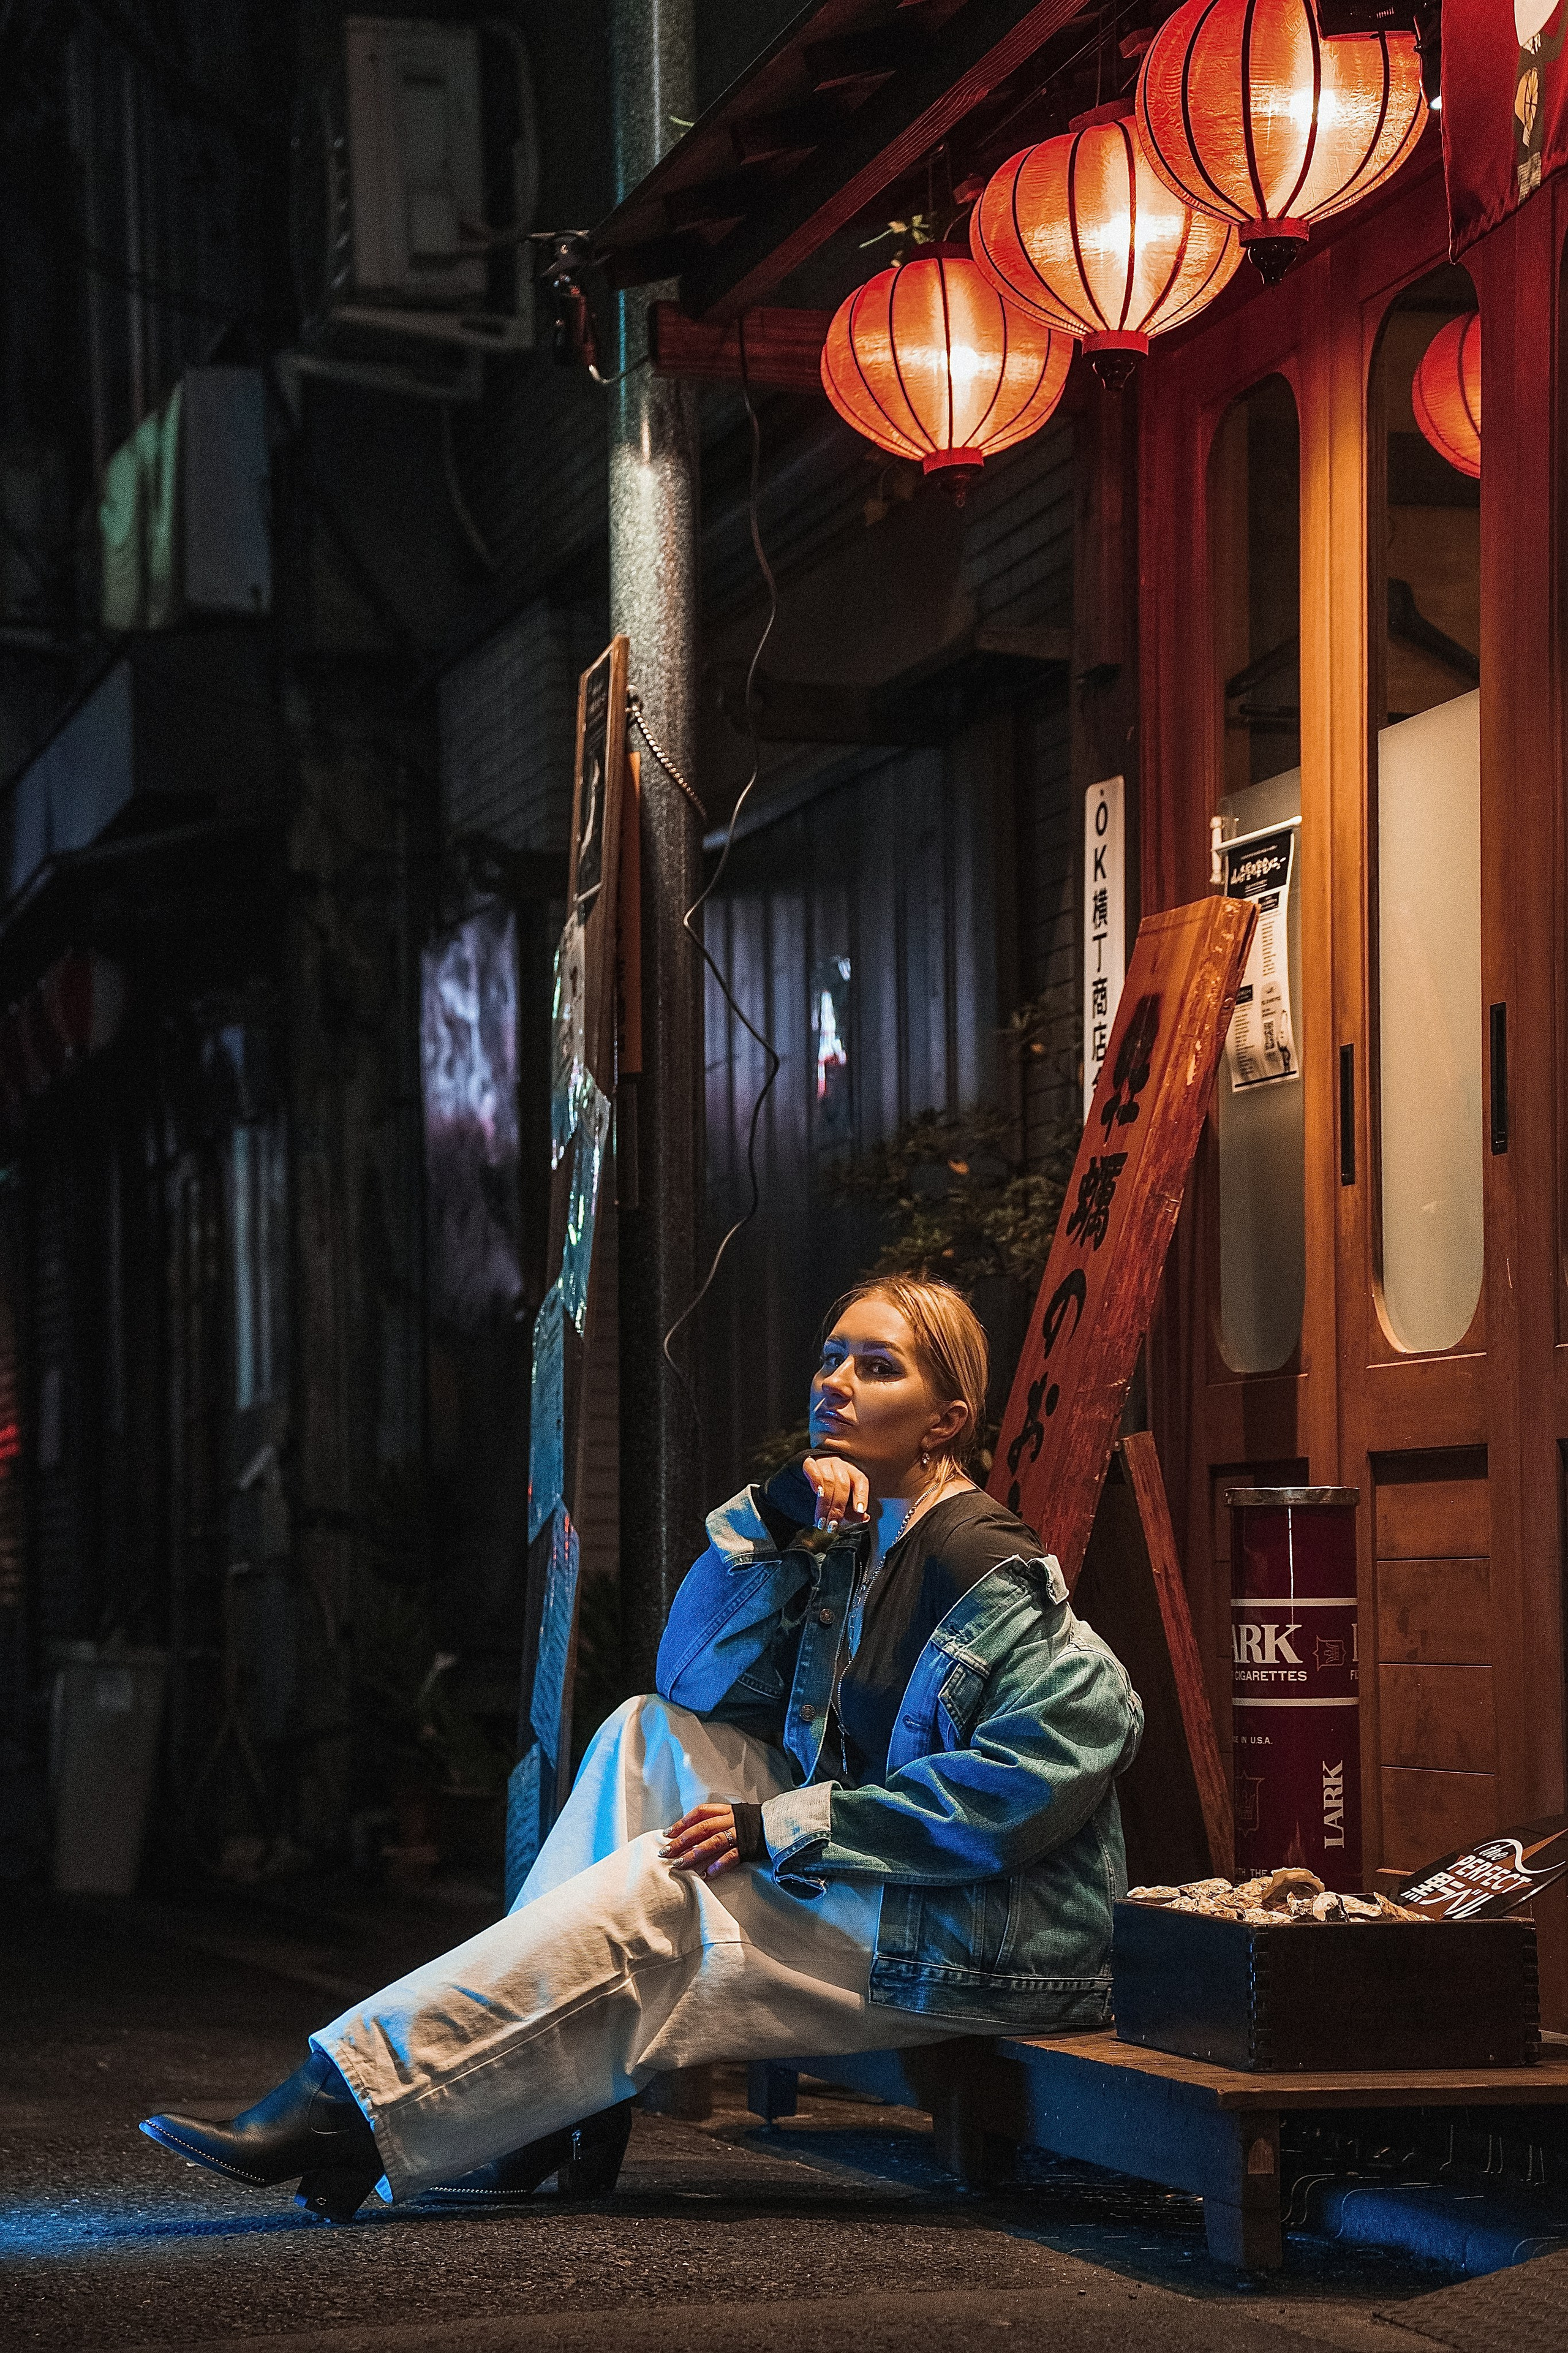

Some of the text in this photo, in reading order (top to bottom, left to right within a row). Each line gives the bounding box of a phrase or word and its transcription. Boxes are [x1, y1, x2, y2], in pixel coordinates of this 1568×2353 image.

[1250, 1736, 1273, 1745] U.S.A.
[1322, 1760, 1344, 1849] LARK
[1400, 1872, 1494, 1919] 黒ラベル
[1446, 1855, 1532, 1894] PERFECT
